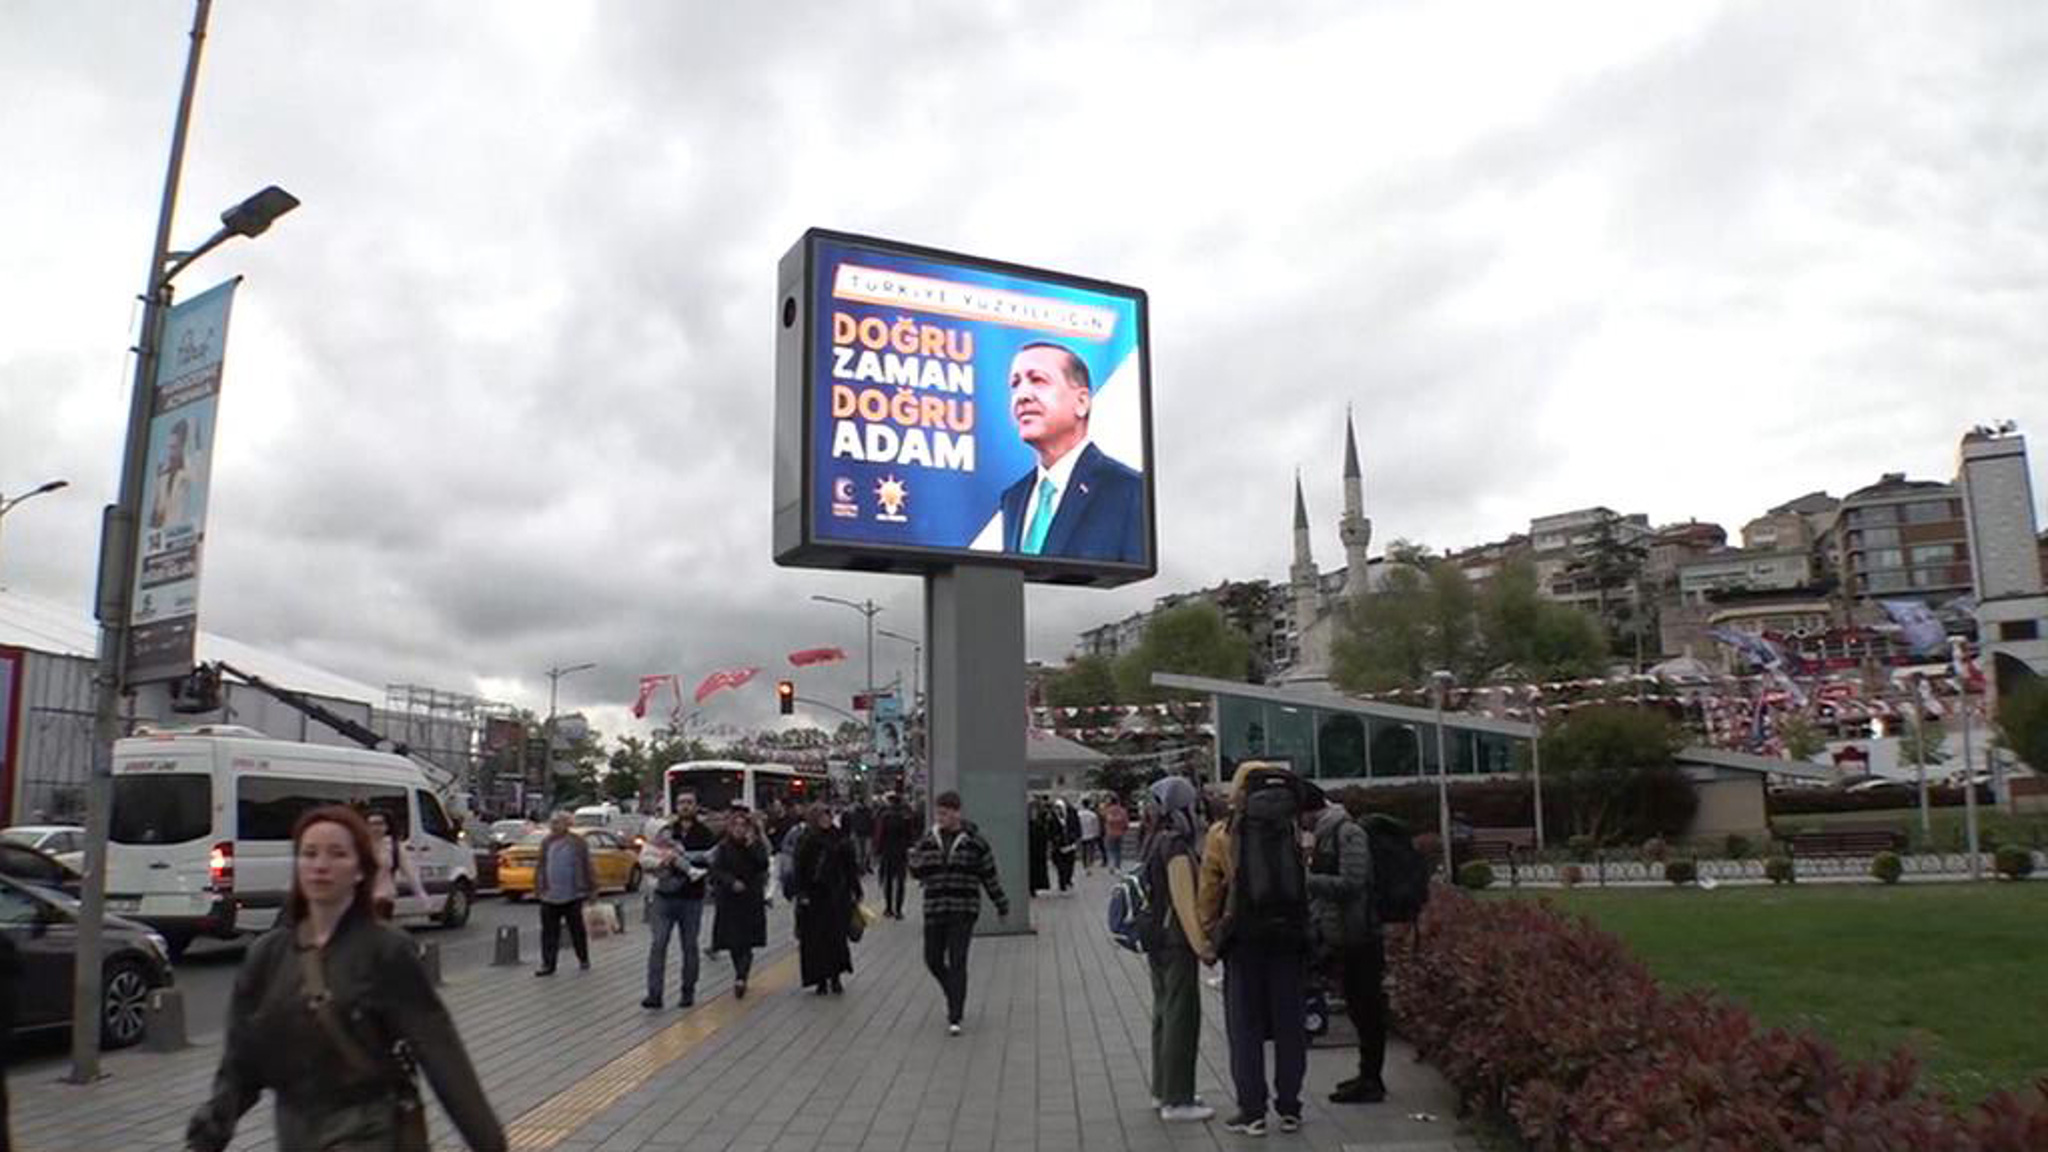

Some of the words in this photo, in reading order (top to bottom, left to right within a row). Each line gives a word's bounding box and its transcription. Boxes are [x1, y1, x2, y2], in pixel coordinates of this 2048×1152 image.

[833, 311, 974, 362] DOĞRU
[832, 346, 975, 395] ZAMAN
[832, 385, 975, 432] DOĞRU
[832, 419, 976, 472] ADAM
